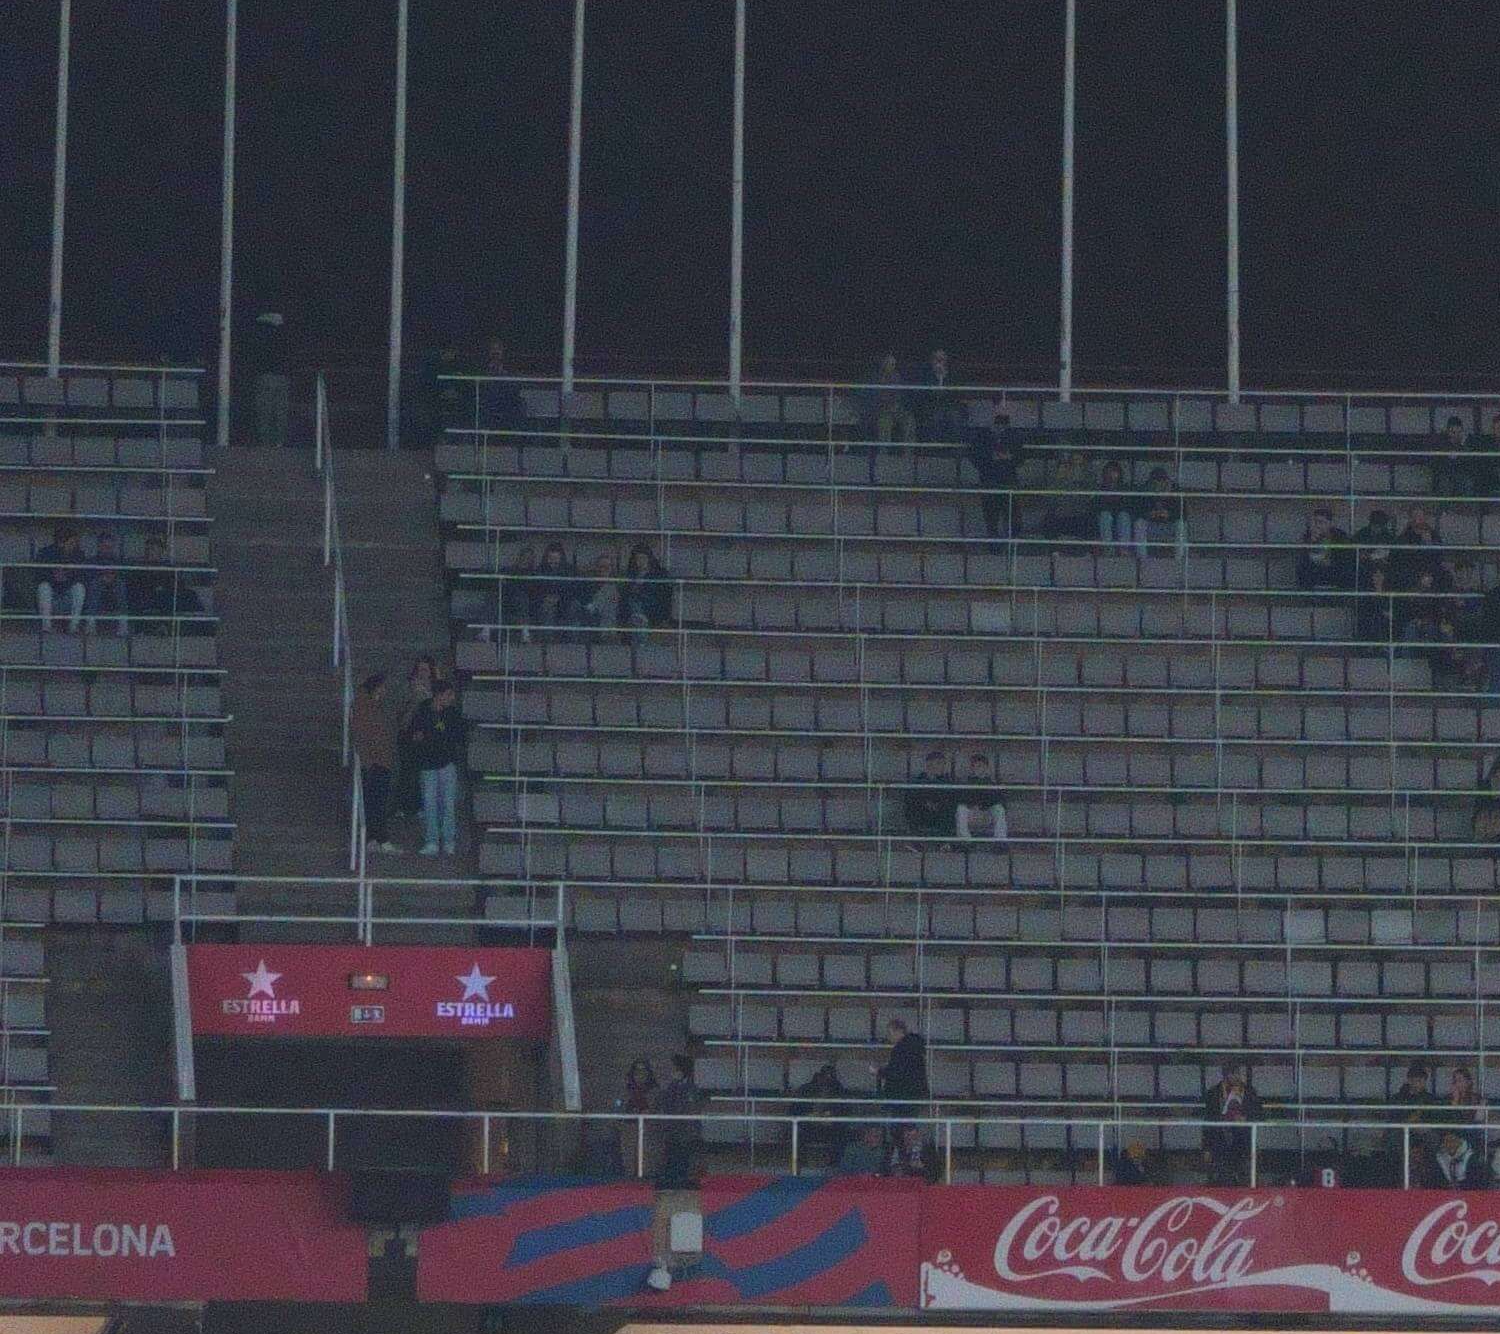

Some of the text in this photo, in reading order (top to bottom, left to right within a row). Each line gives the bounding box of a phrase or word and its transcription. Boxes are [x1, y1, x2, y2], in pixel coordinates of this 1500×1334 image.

[223, 999, 300, 1014] ESTRELLA
[436, 1002, 514, 1017] ESTRELLA
[0, 1222, 176, 1258] RCELONA
[993, 1195, 1269, 1283] Coca-Cola
